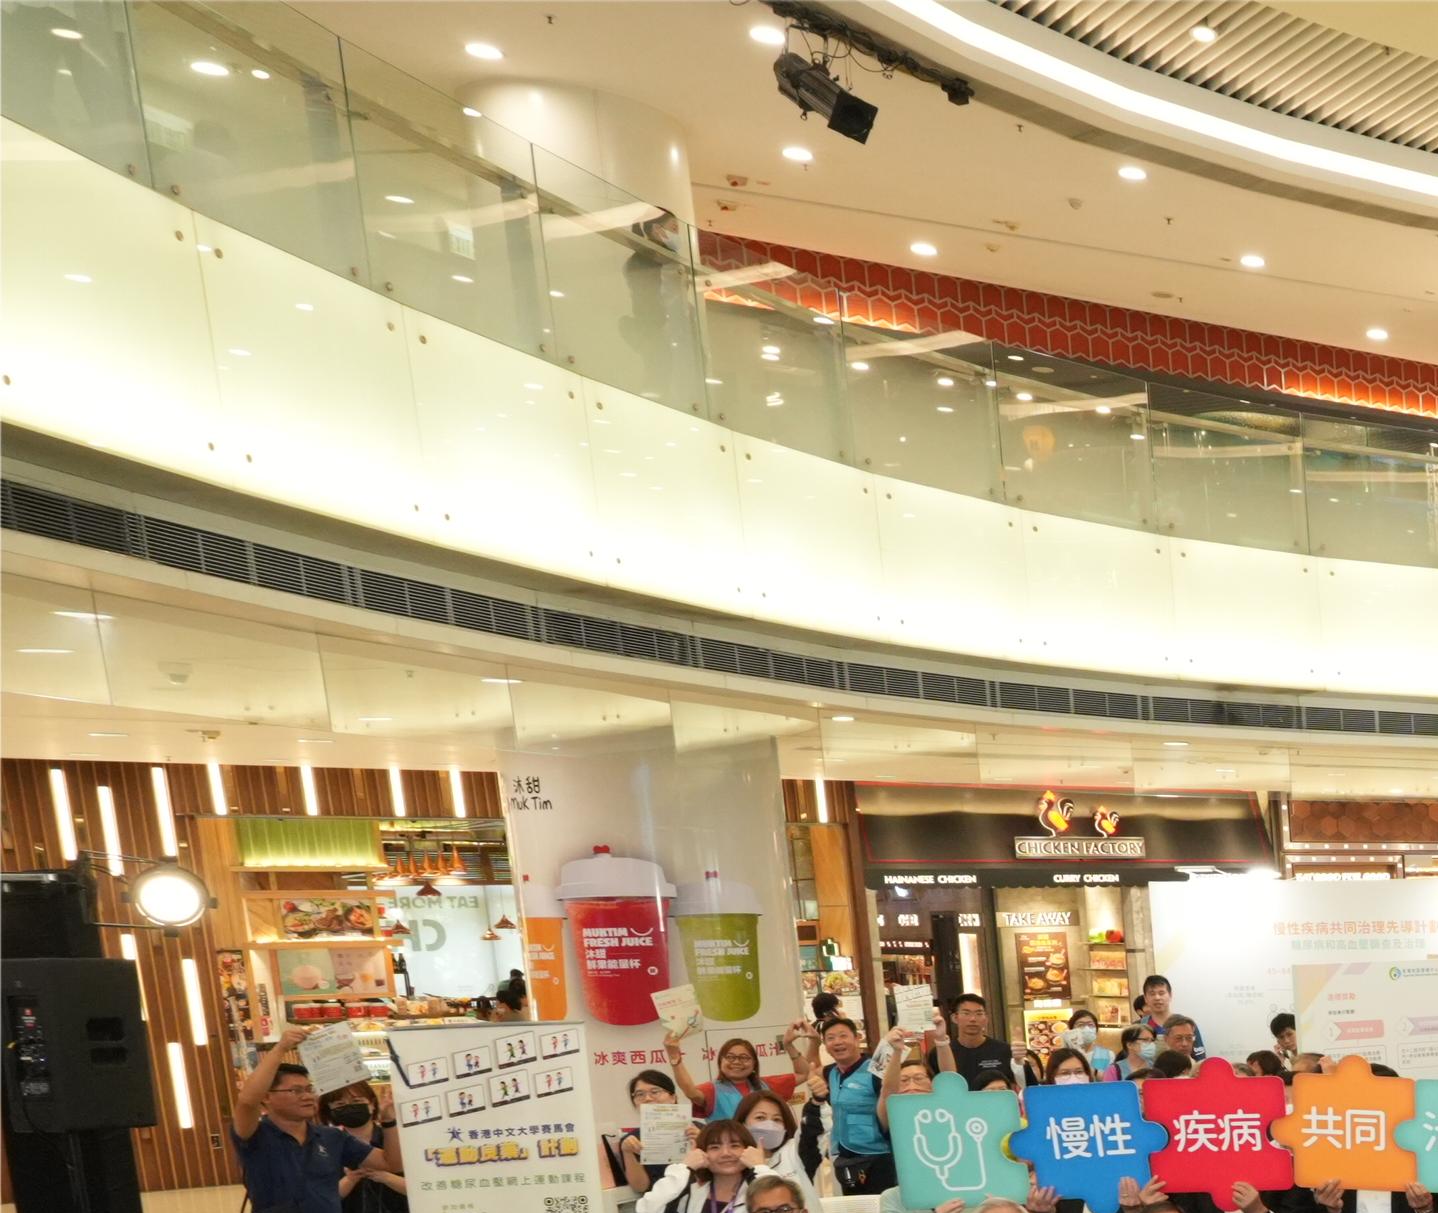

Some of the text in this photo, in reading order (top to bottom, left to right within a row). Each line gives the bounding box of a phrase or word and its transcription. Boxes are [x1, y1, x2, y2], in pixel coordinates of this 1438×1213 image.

[532, 796, 553, 810] Tim
[1016, 841, 1145, 855] CHICKEN FACTORY
[884, 874, 978, 885] HAINANESE CHICKEN
[1053, 873, 1120, 884] CURRY CHICKEN
[1002, 911, 1072, 926] TAKE AWAY
[582, 927, 629, 938] MUKTIM
[583, 936, 654, 948] FRESH JUICE
[468, 1122, 576, 1140] 香港中文大學賽馬會
[1172, 1109, 1263, 1152] 疾病
[1301, 1107, 1386, 1150] 共同
[1045, 1115, 1136, 1158] 慢性
